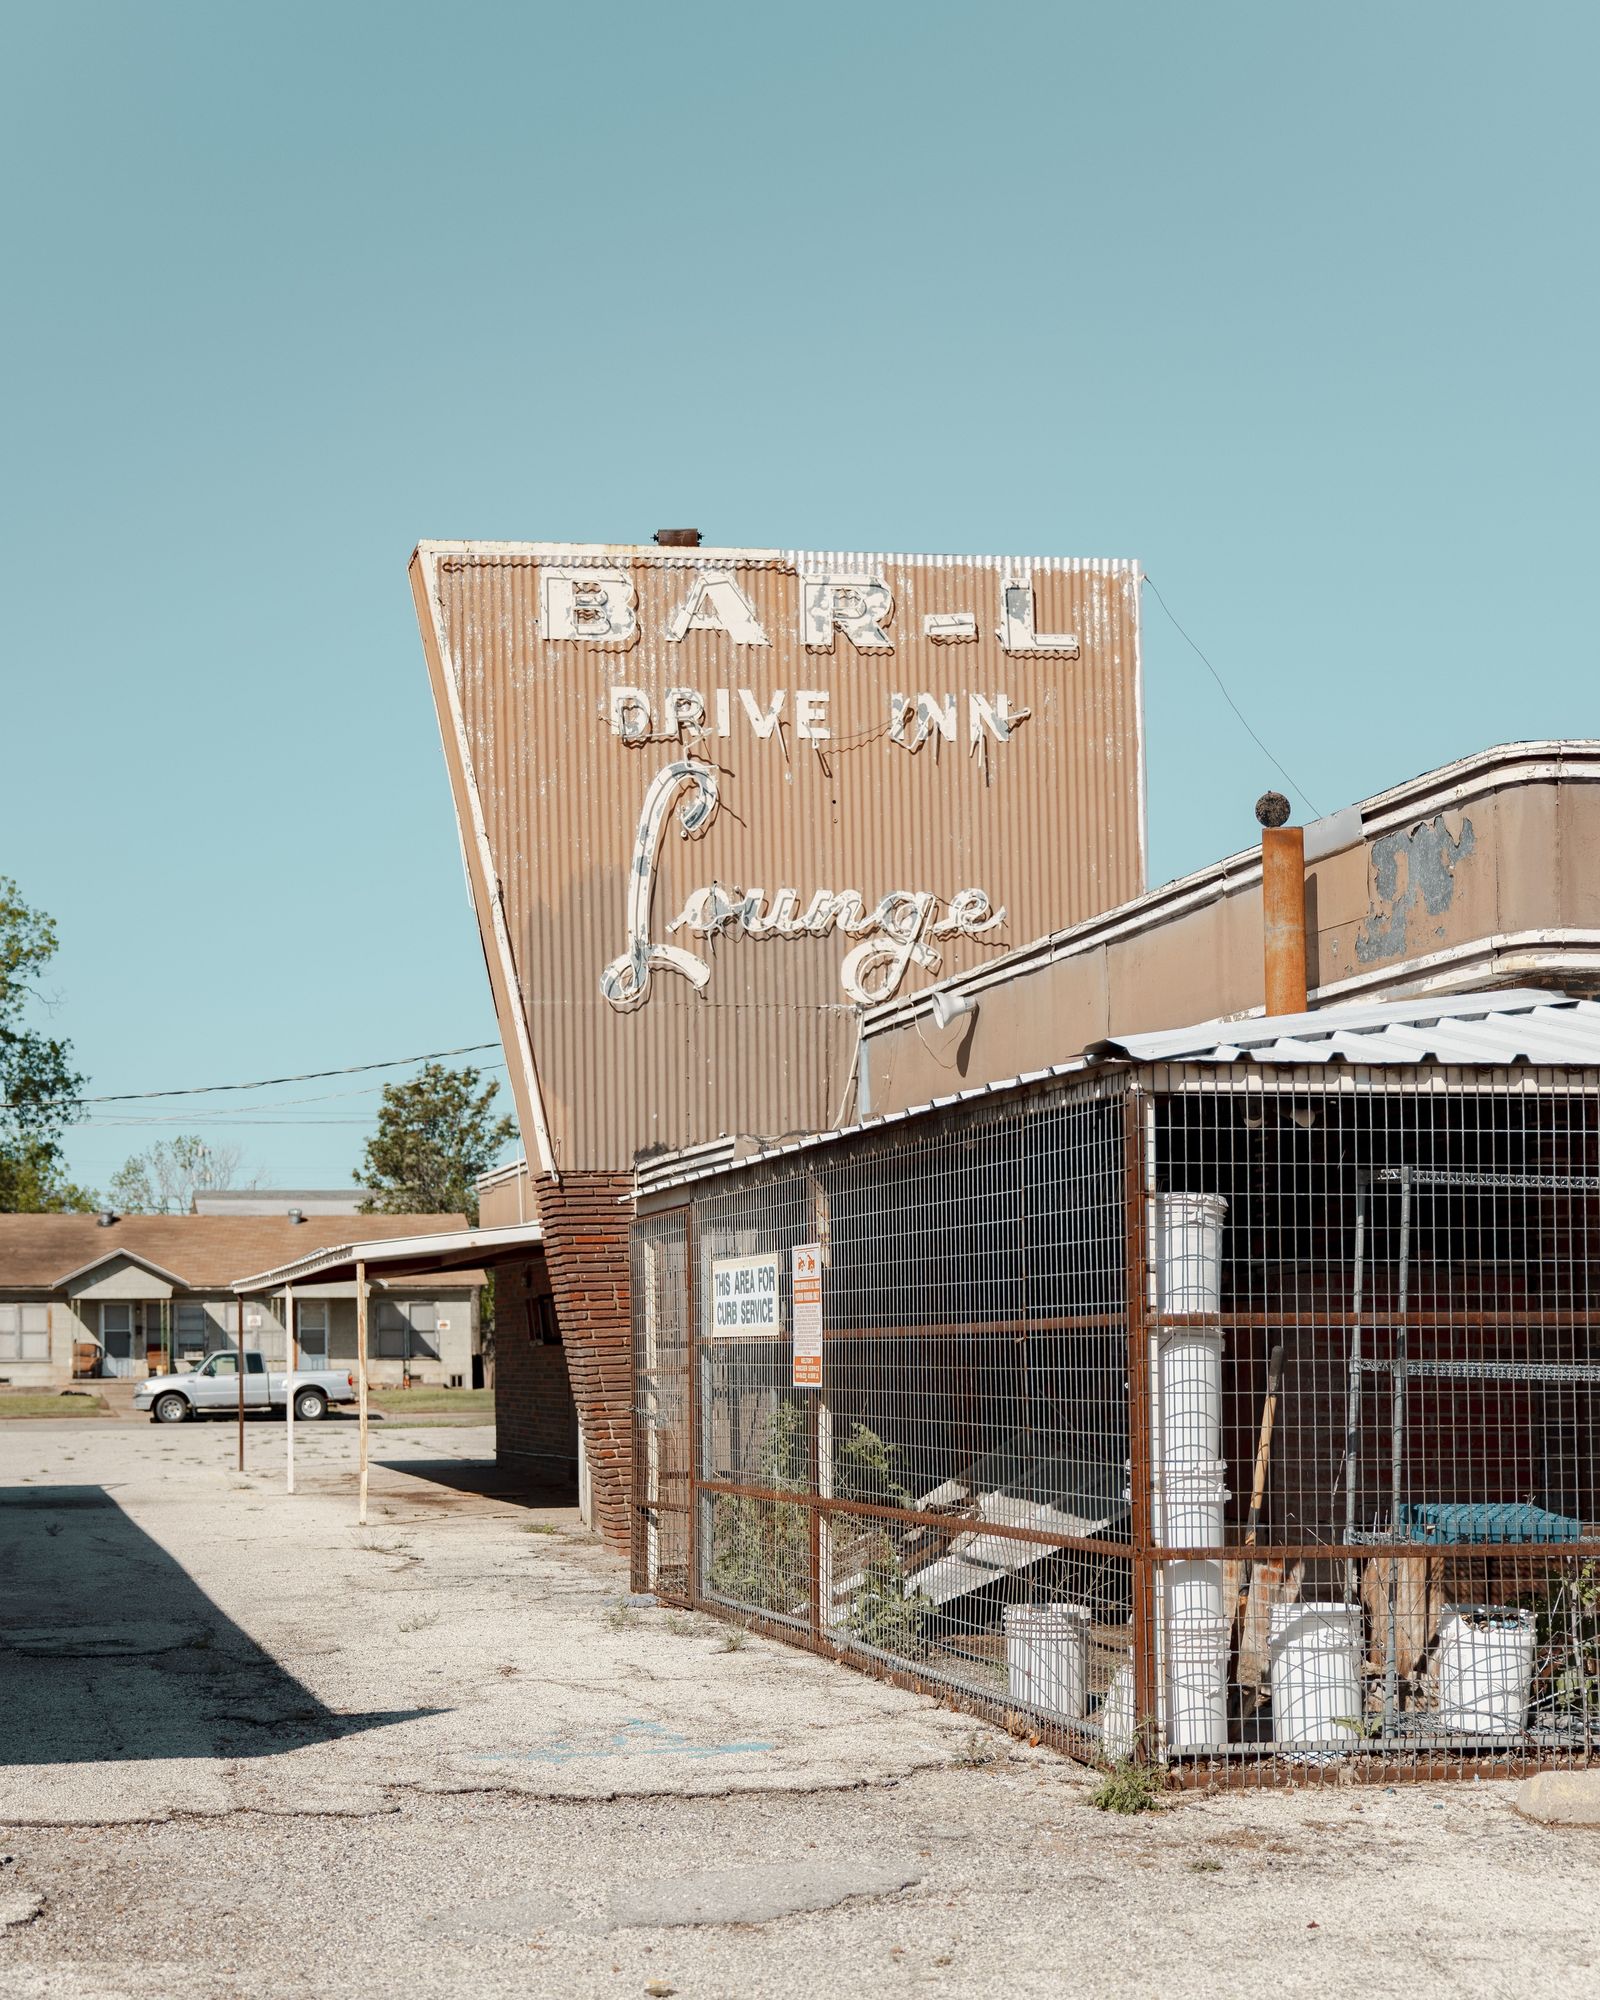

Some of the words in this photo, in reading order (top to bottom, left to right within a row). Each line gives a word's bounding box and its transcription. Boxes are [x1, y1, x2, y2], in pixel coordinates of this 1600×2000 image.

[540, 568, 1079, 652] BAR-L
[610, 686, 831, 739] DRIVE
[889, 690, 1012, 743] INN
[600, 760, 1007, 1005] Lounge
[715, 1271, 731, 1297] THIS
[734, 1269, 756, 1296] AREA
[757, 1266, 776, 1293] FOR
[716, 1301, 738, 1326] CURB
[740, 1297, 774, 1325] SERVICE
